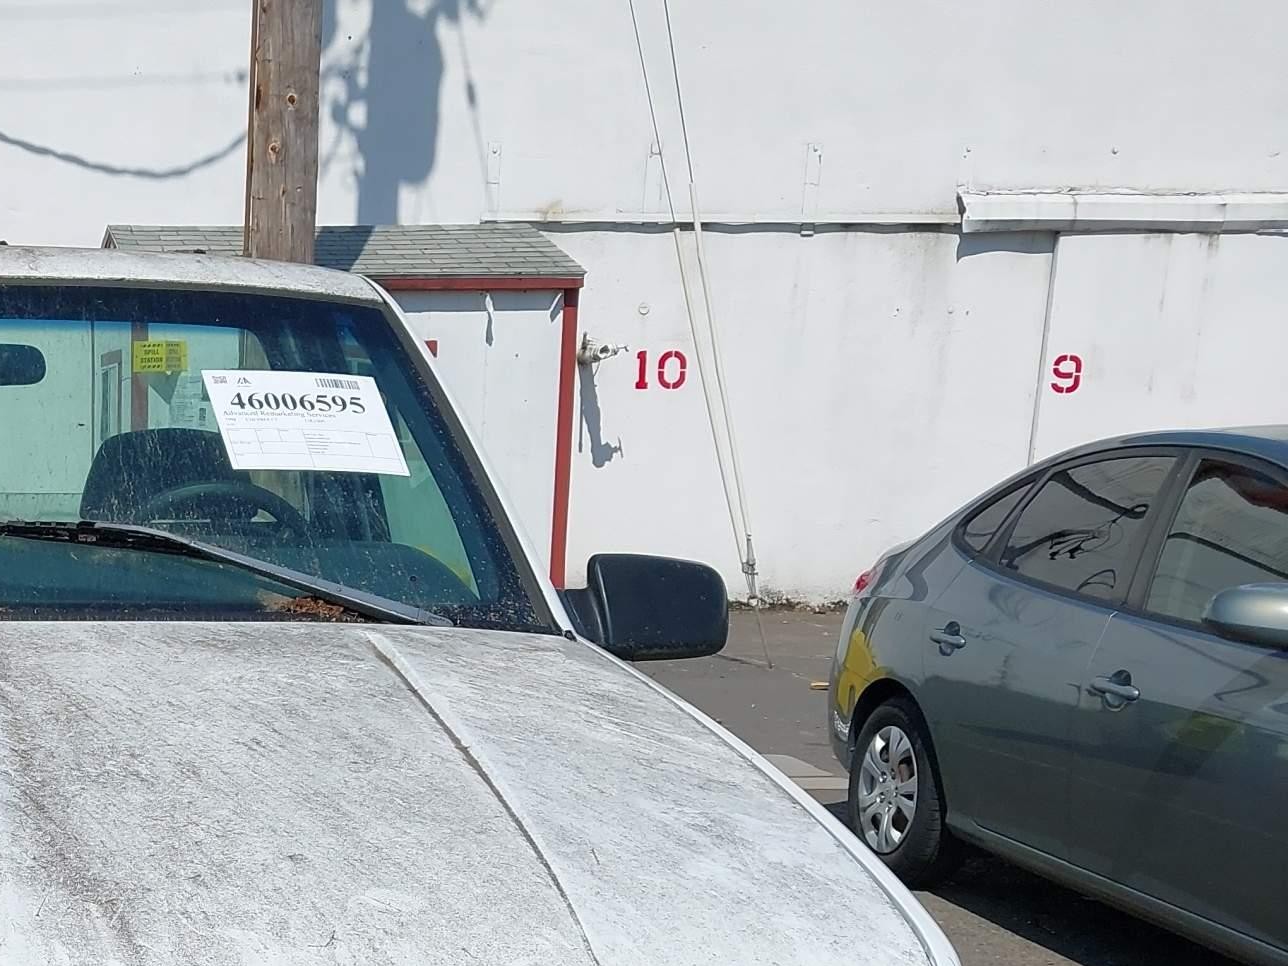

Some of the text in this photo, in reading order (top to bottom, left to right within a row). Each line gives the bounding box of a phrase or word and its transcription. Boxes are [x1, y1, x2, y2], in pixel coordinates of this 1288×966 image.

[140, 356, 164, 364] STATION
[634, 351, 687, 391] 10
[1051, 354, 1083, 394] 9
[230, 392, 366, 415] 46006595
